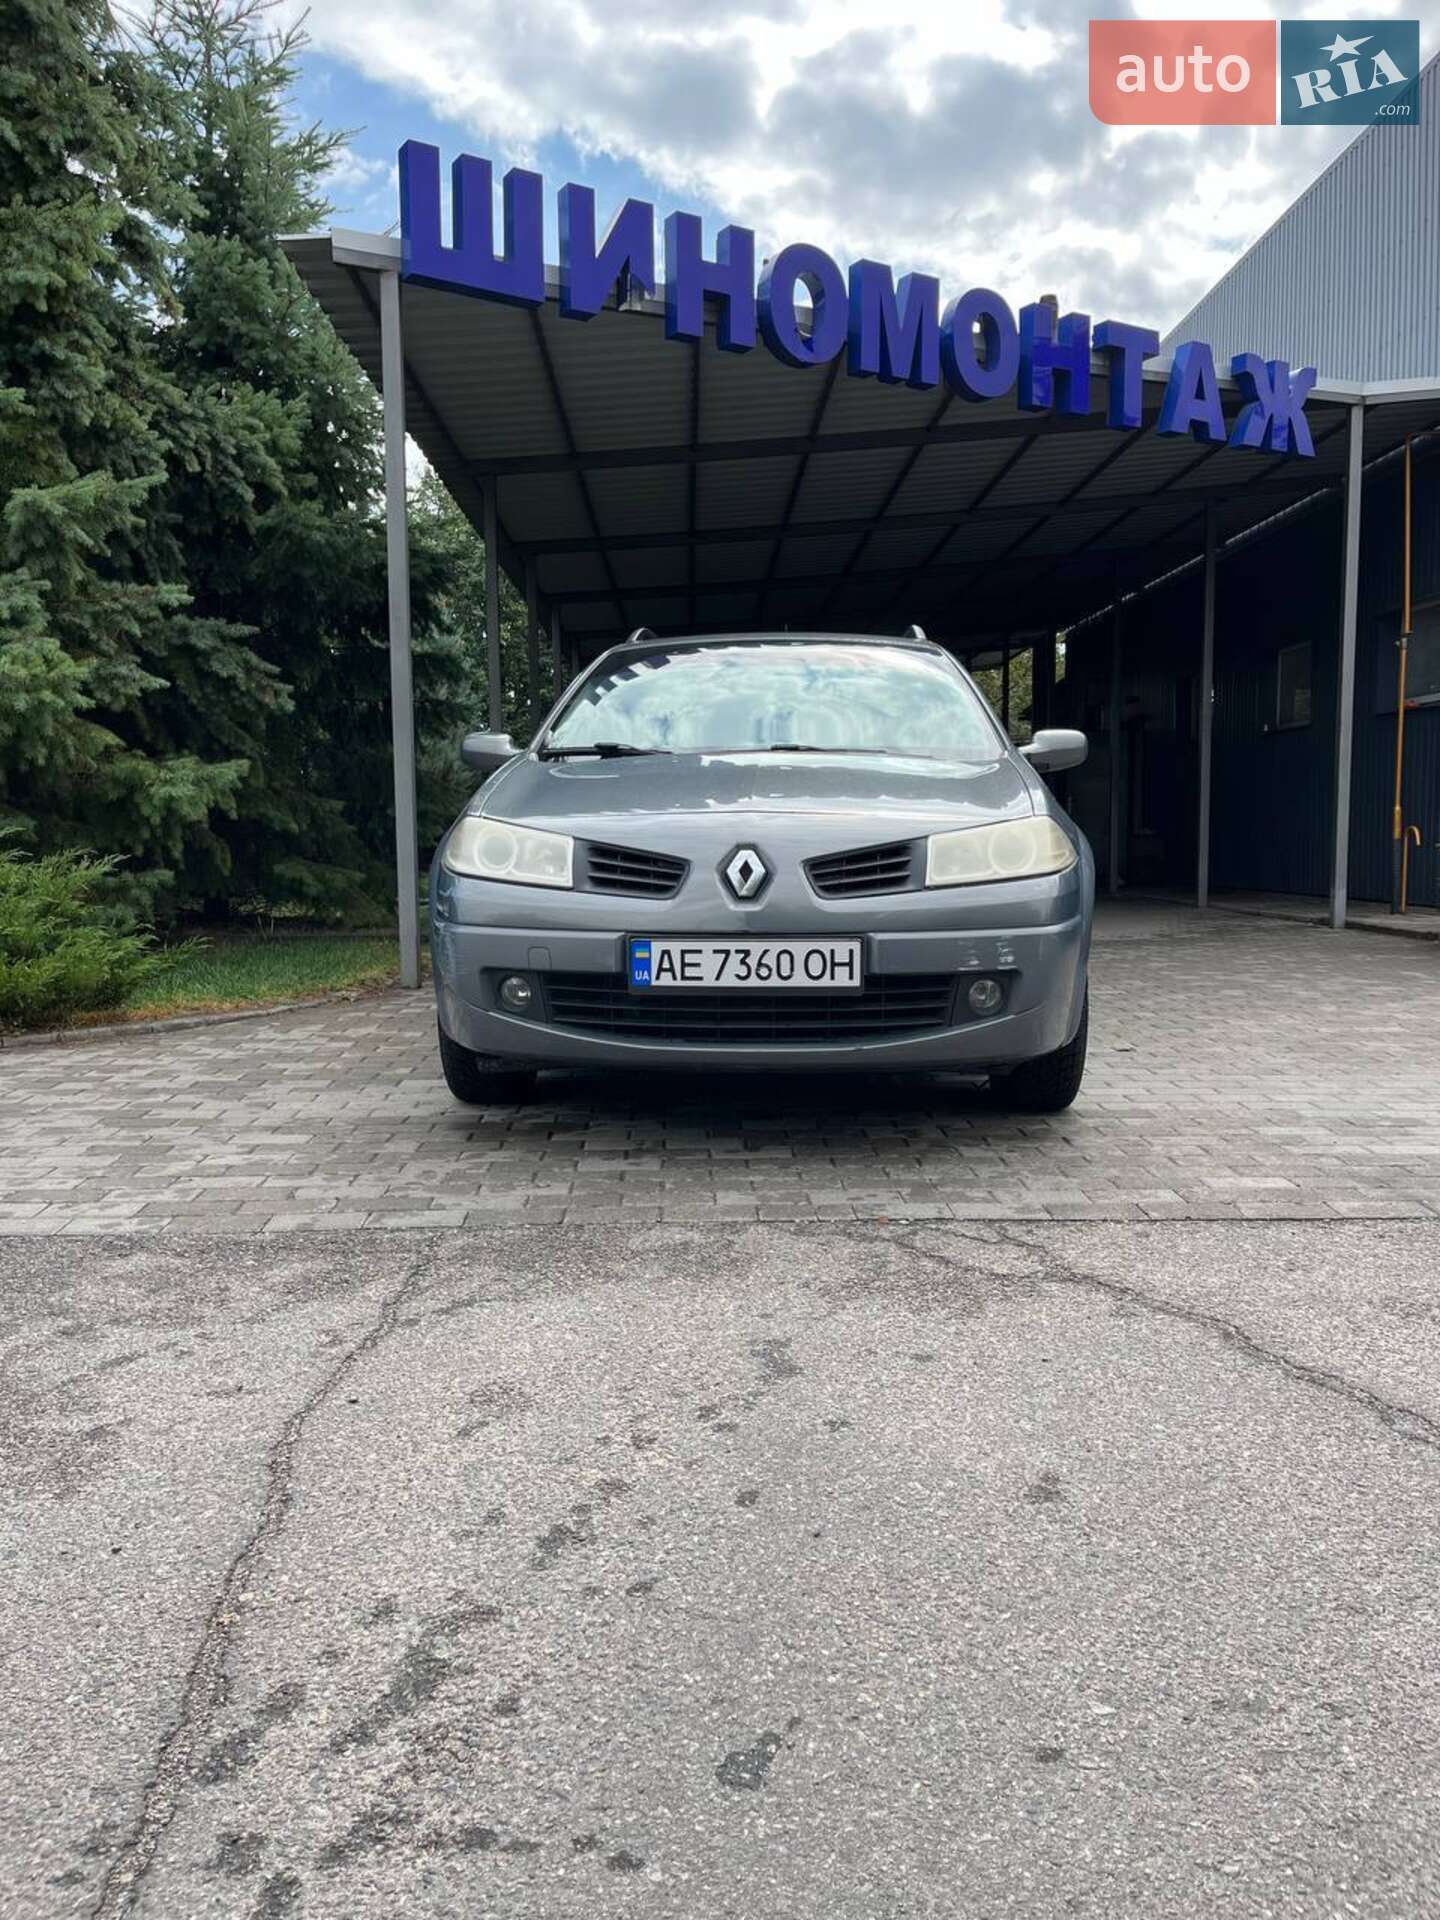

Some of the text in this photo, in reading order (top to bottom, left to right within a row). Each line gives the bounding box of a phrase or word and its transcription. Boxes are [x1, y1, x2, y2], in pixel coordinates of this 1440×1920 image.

[398, 138, 1317, 458] ШИНОМОНТАЖ
[635, 970, 650, 981] UA
[655, 948, 855, 982] AE 7360 OH
